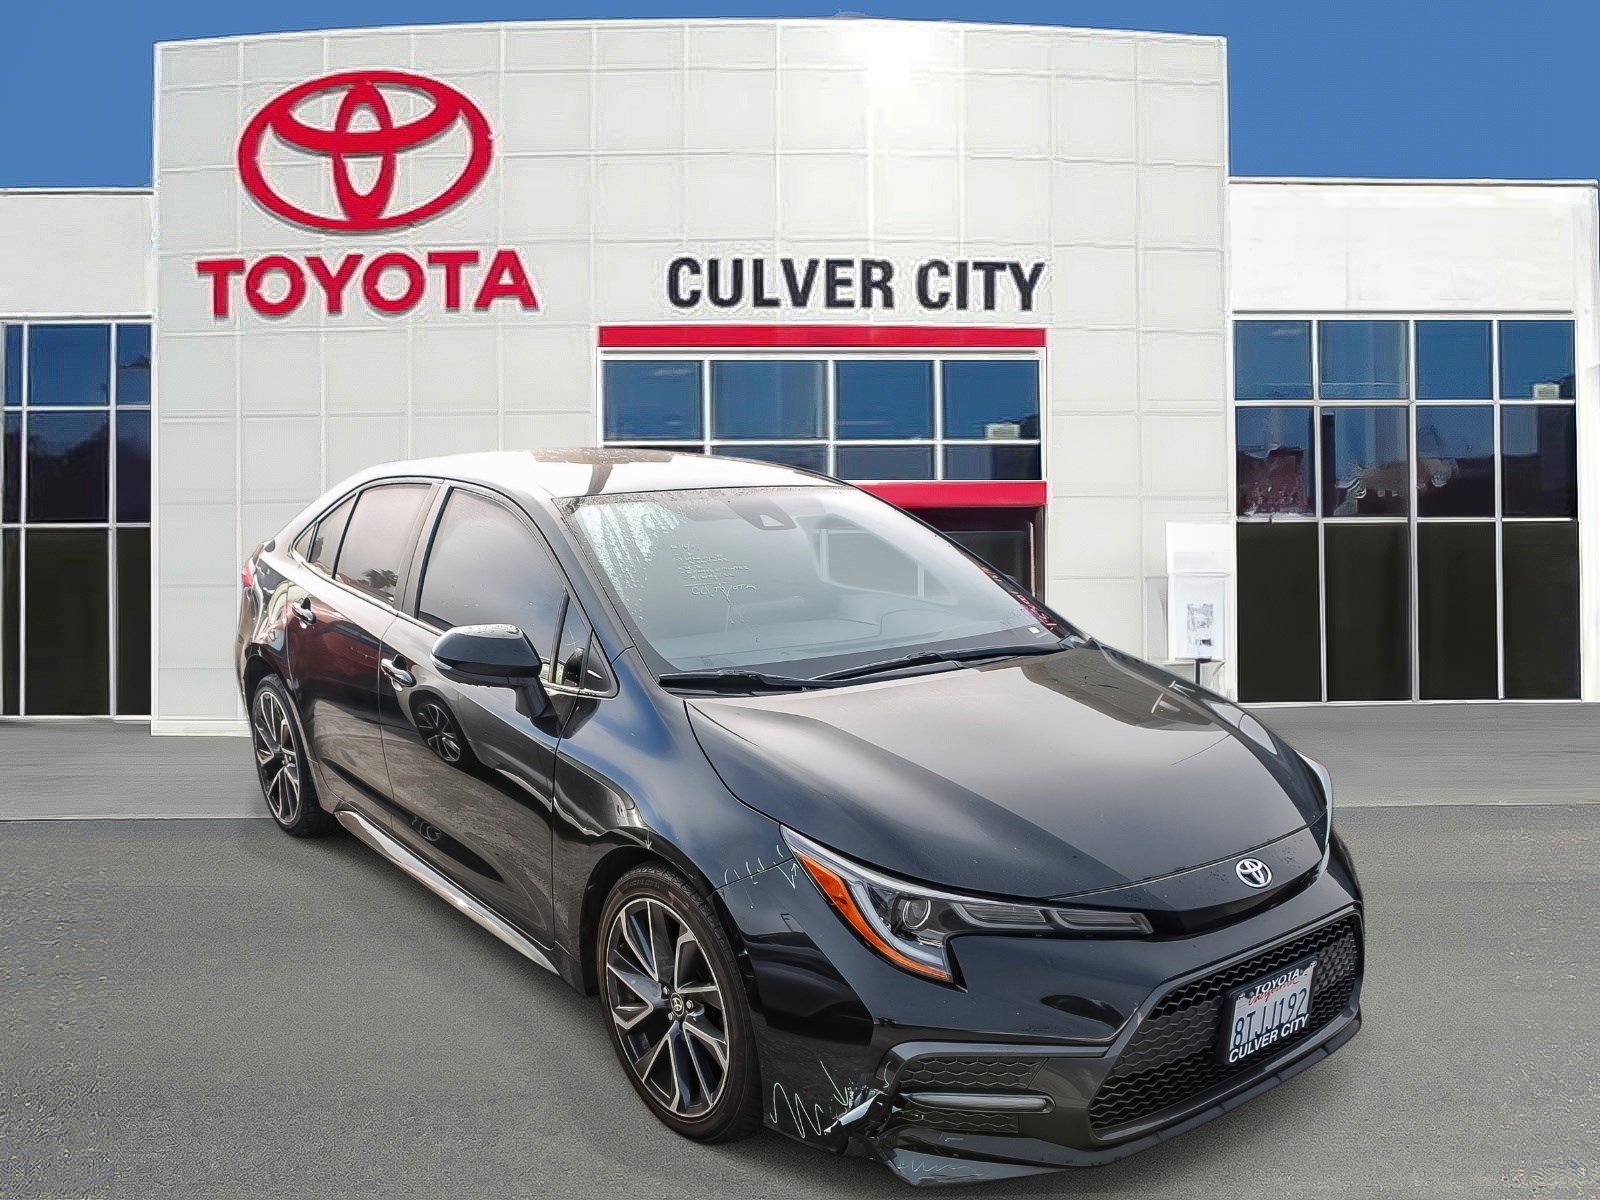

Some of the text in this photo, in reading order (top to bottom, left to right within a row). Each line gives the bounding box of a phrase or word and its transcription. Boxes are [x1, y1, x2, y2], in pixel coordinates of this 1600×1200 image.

[196, 250, 539, 318] TOYOTA
[667, 257, 1046, 311] CULVER CITY
[1255, 968, 1300, 996] TOYOTA
[1229, 1013, 1310, 1063] CULVER CITY
[1233, 988, 1307, 1048] 8TJJ192
